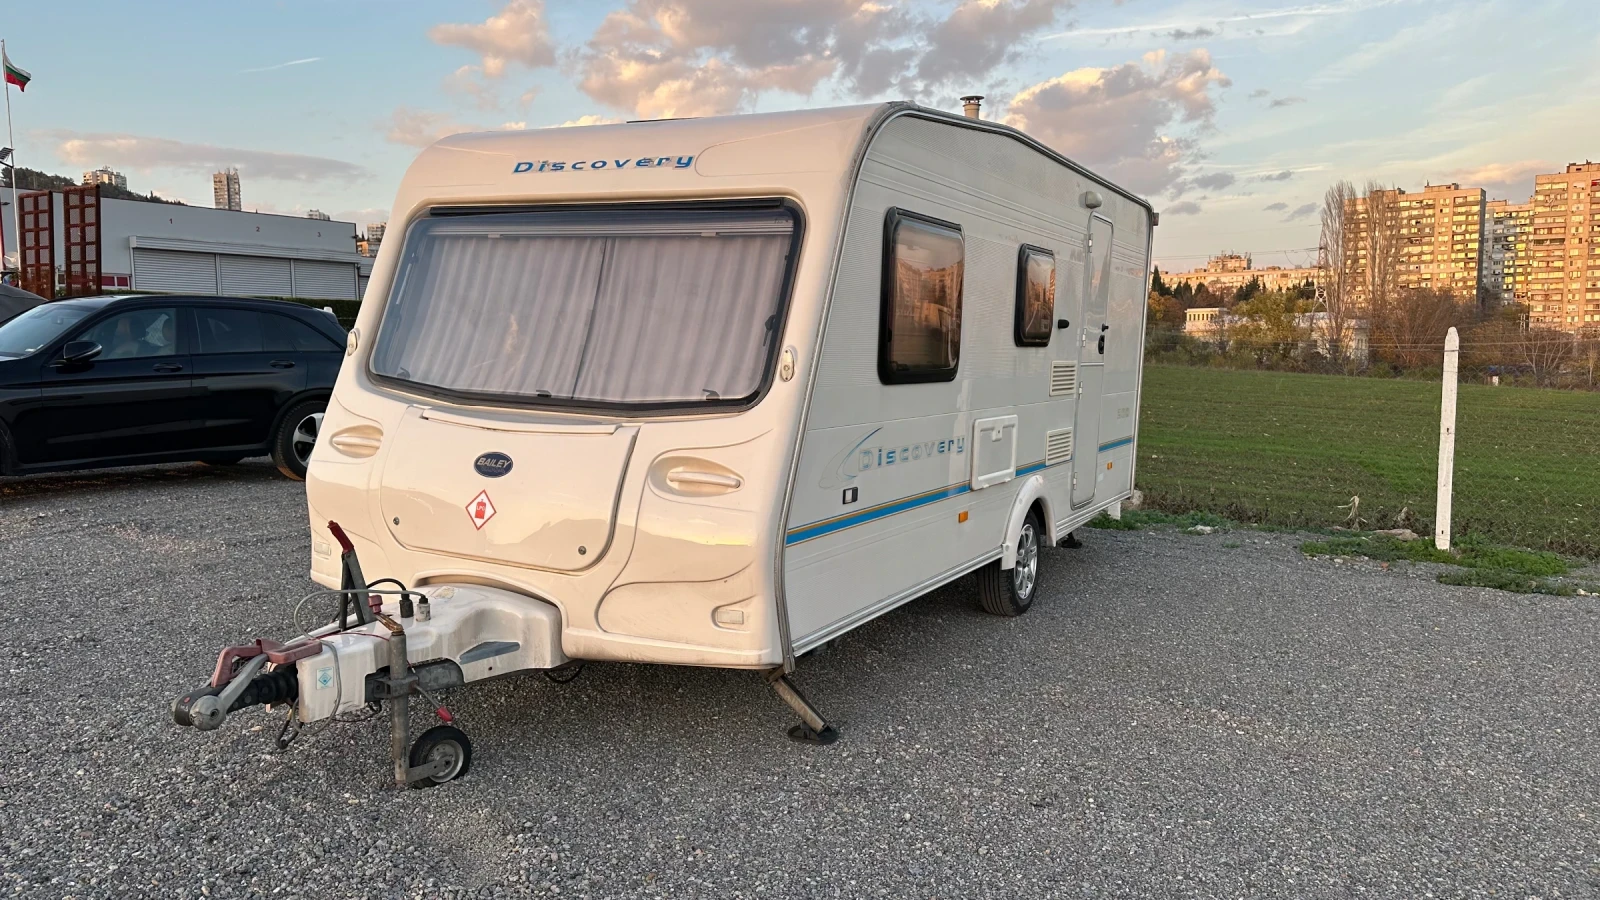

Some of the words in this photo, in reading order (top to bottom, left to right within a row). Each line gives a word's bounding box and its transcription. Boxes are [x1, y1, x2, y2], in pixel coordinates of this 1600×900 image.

[512, 156, 694, 174] Discovery
[477, 457, 512, 468] BAILEY
[859, 438, 965, 470] Discovery
